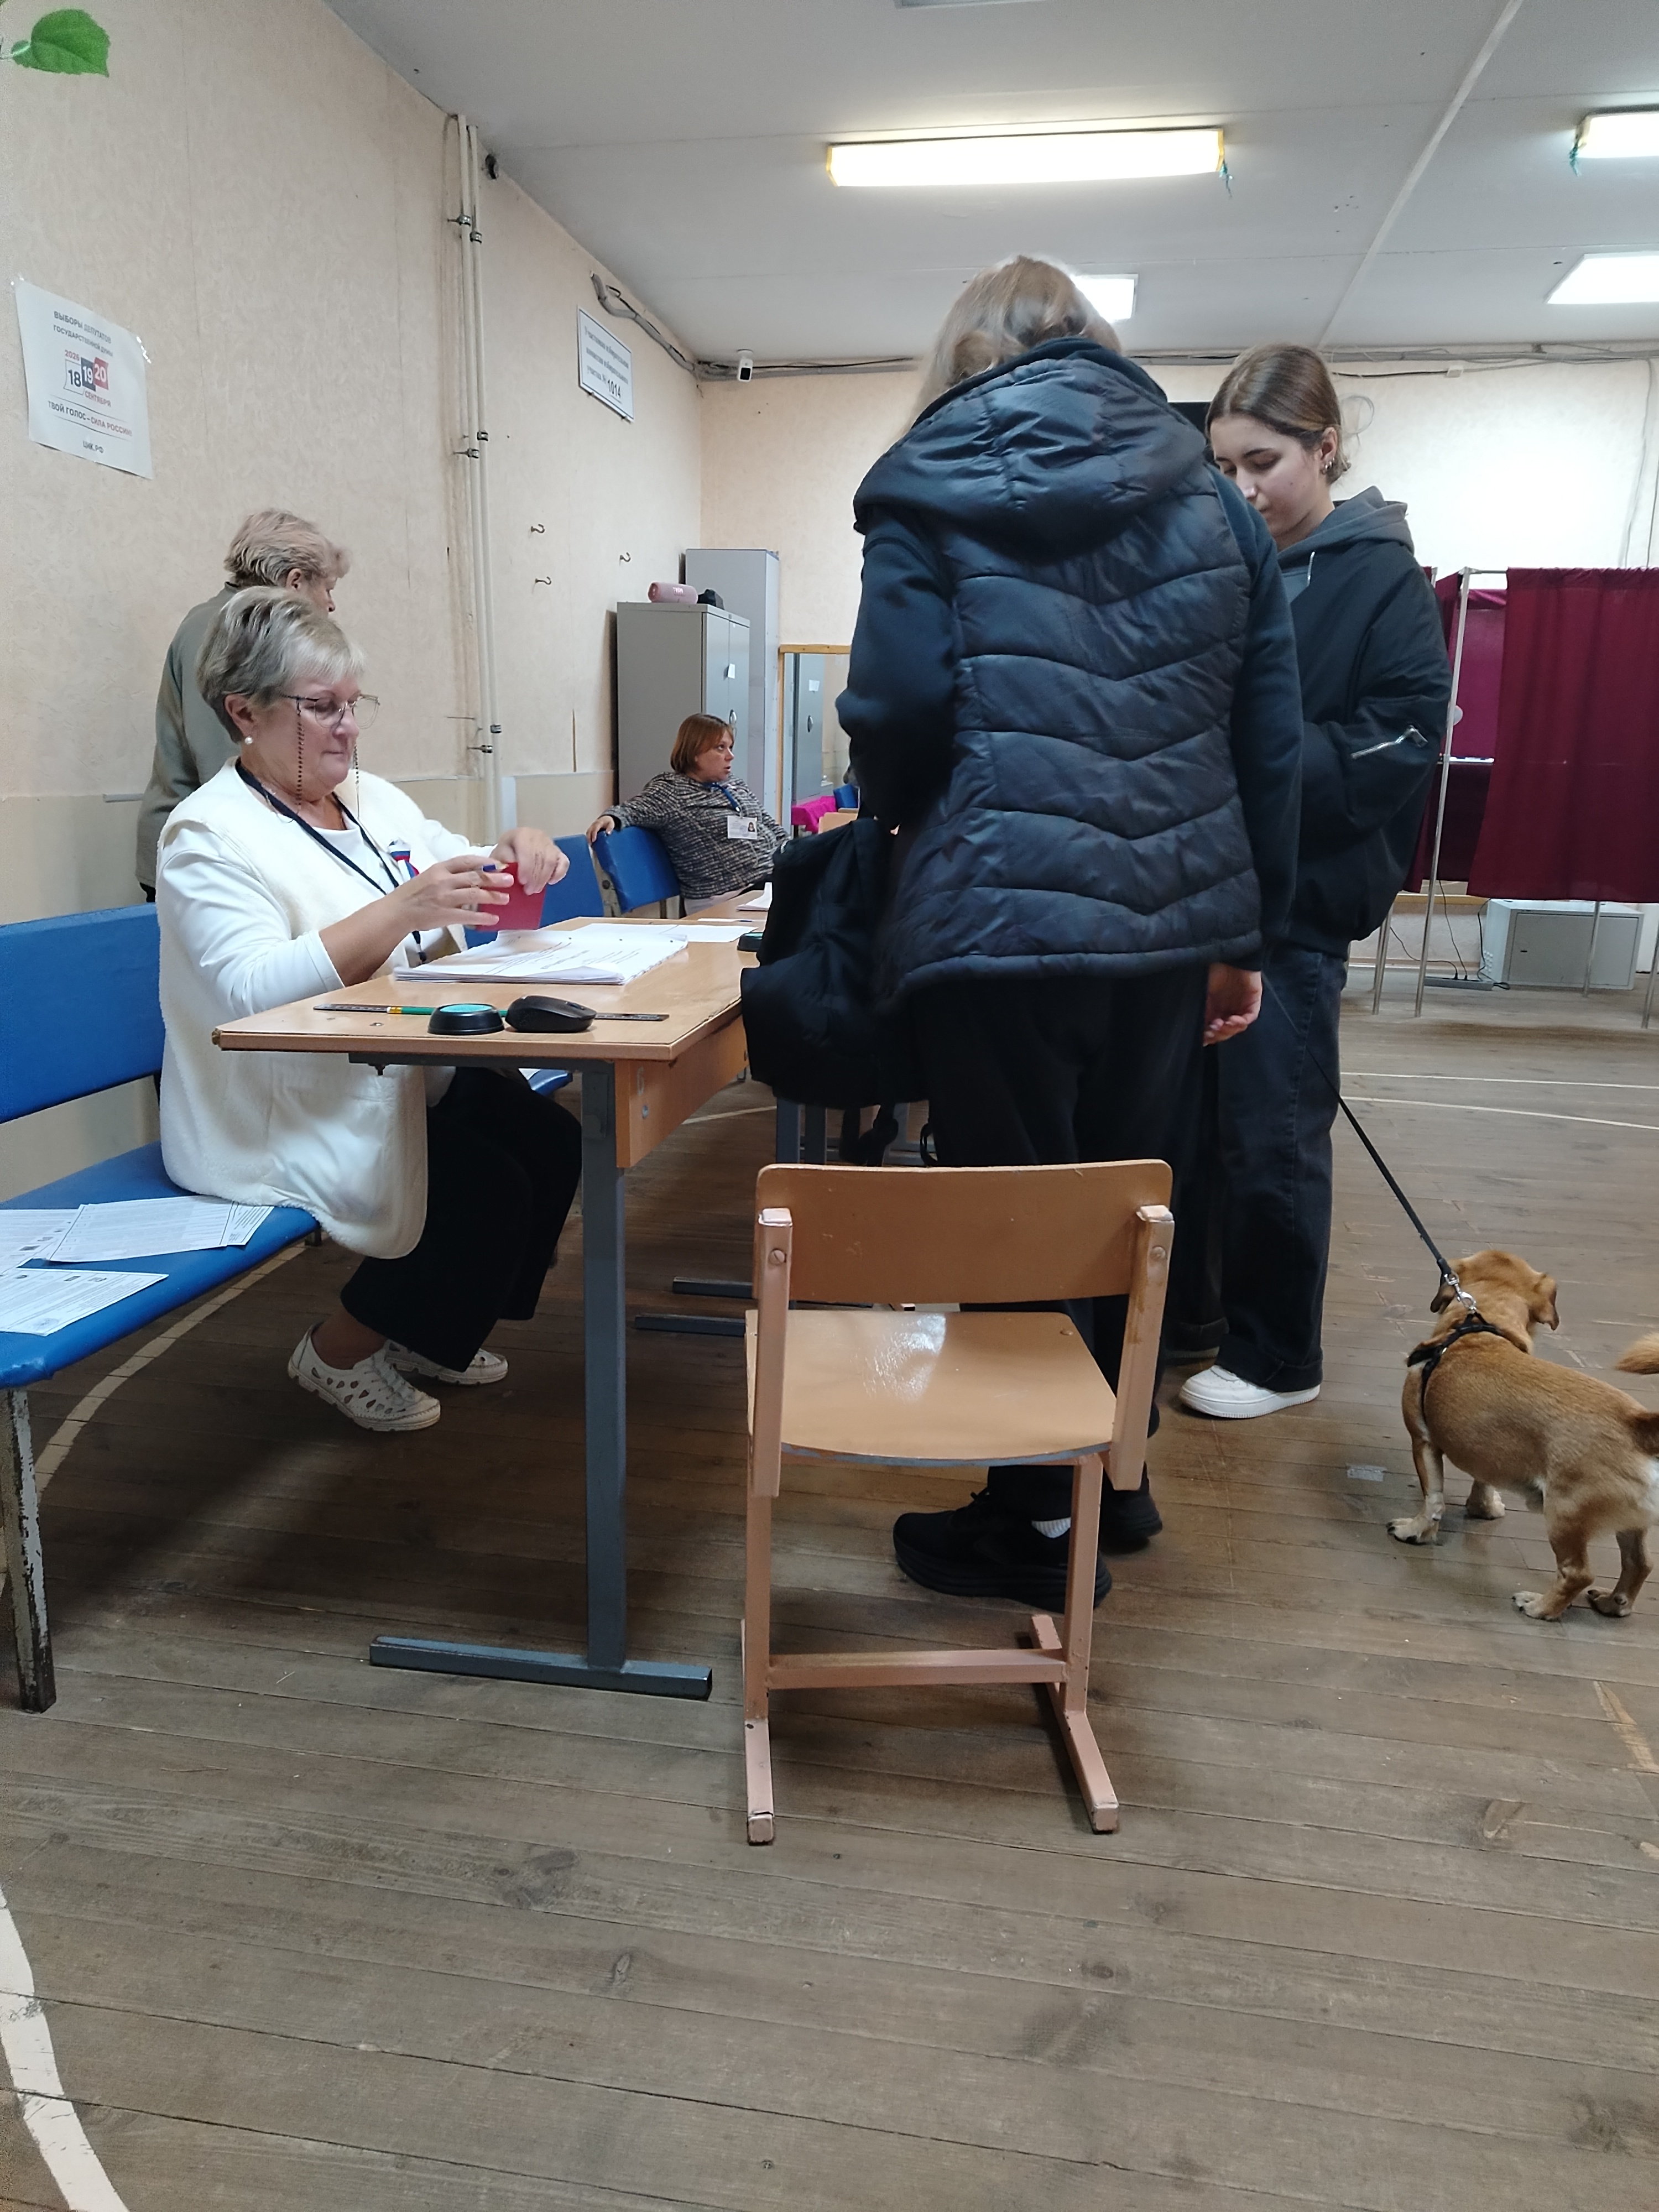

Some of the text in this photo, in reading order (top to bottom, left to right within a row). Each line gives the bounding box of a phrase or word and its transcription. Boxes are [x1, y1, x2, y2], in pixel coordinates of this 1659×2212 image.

[54, 311, 83, 328] ВЫБОРЫ
[68, 363, 107, 388] 18 19 20
[85, 390, 112, 408] СЕНТЯБРЯ
[607, 379, 621, 399] 1014
[48, 400, 65, 414] ТВОЙ
[66, 406, 86, 420] ГОЛОС
[91, 416, 106, 429] СИЛА
